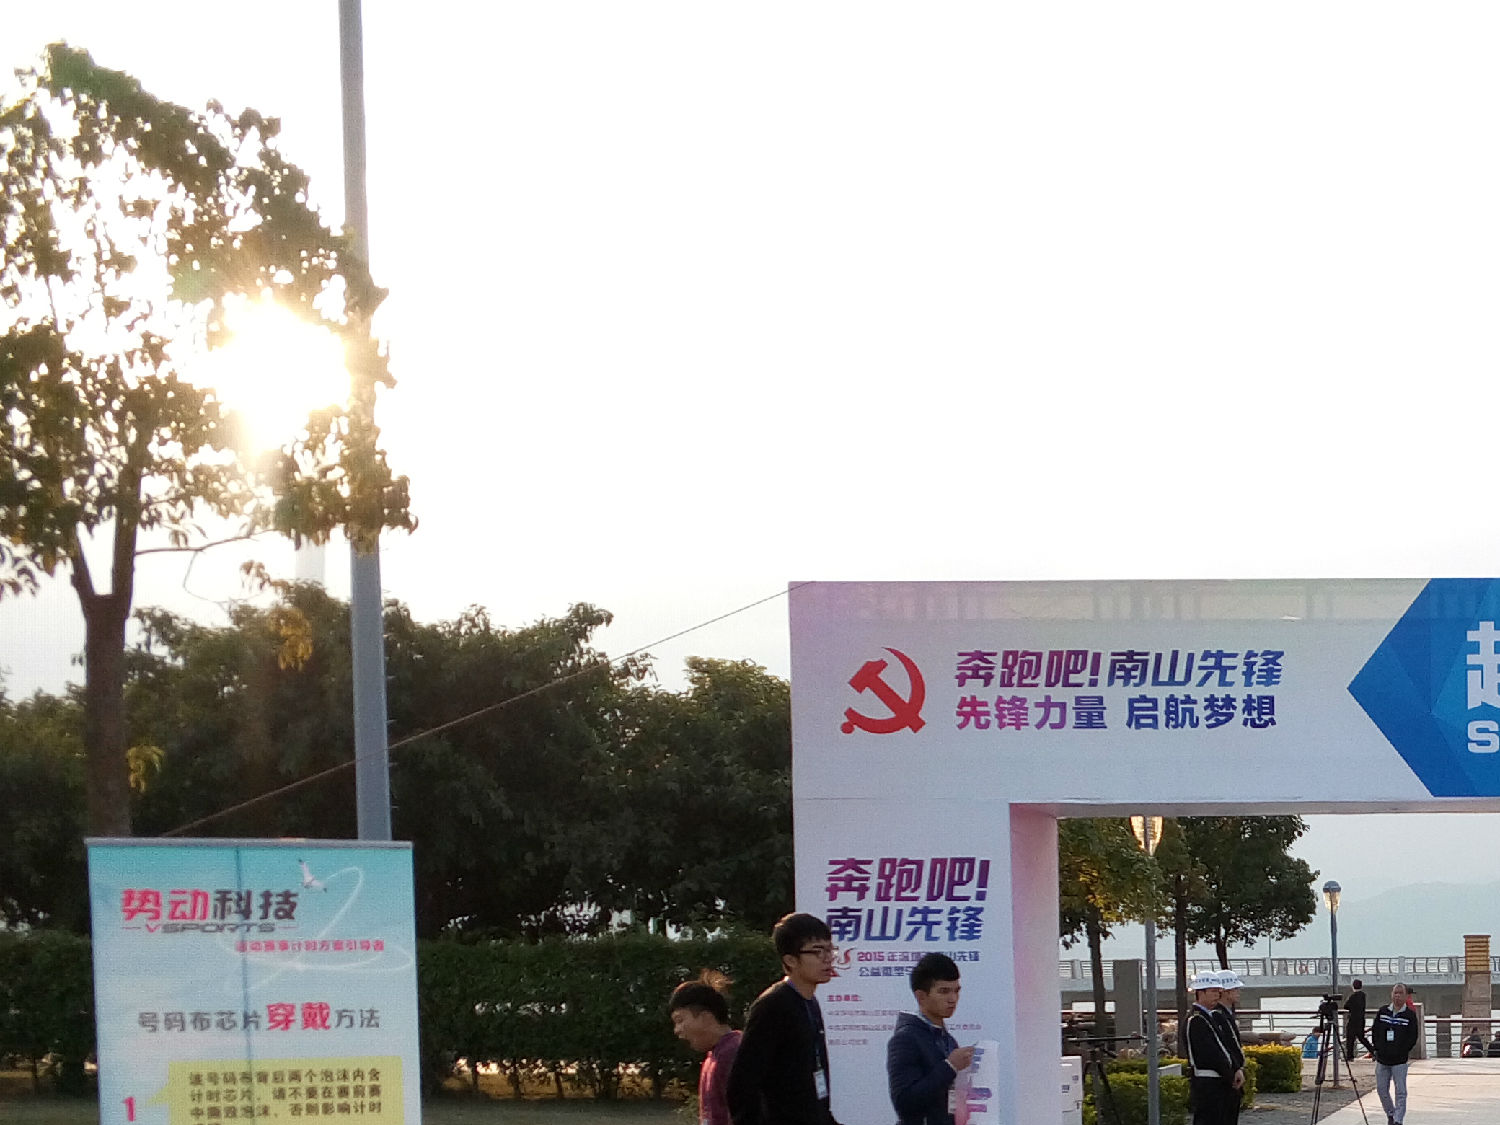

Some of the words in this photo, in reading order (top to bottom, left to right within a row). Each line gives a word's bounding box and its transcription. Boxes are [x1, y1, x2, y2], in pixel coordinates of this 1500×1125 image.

[956, 695, 1107, 730] 先锋力量
[1126, 694, 1277, 729] 启航梦想
[825, 857, 991, 902] 奔跑吧!
[121, 888, 299, 921] 势动科技
[145, 924, 276, 933] VSPORTS
[826, 905, 984, 941] 南山先锋
[138, 1002, 380, 1031] 号码布芯片穿戴方法
[122, 1097, 137, 1122] 1
